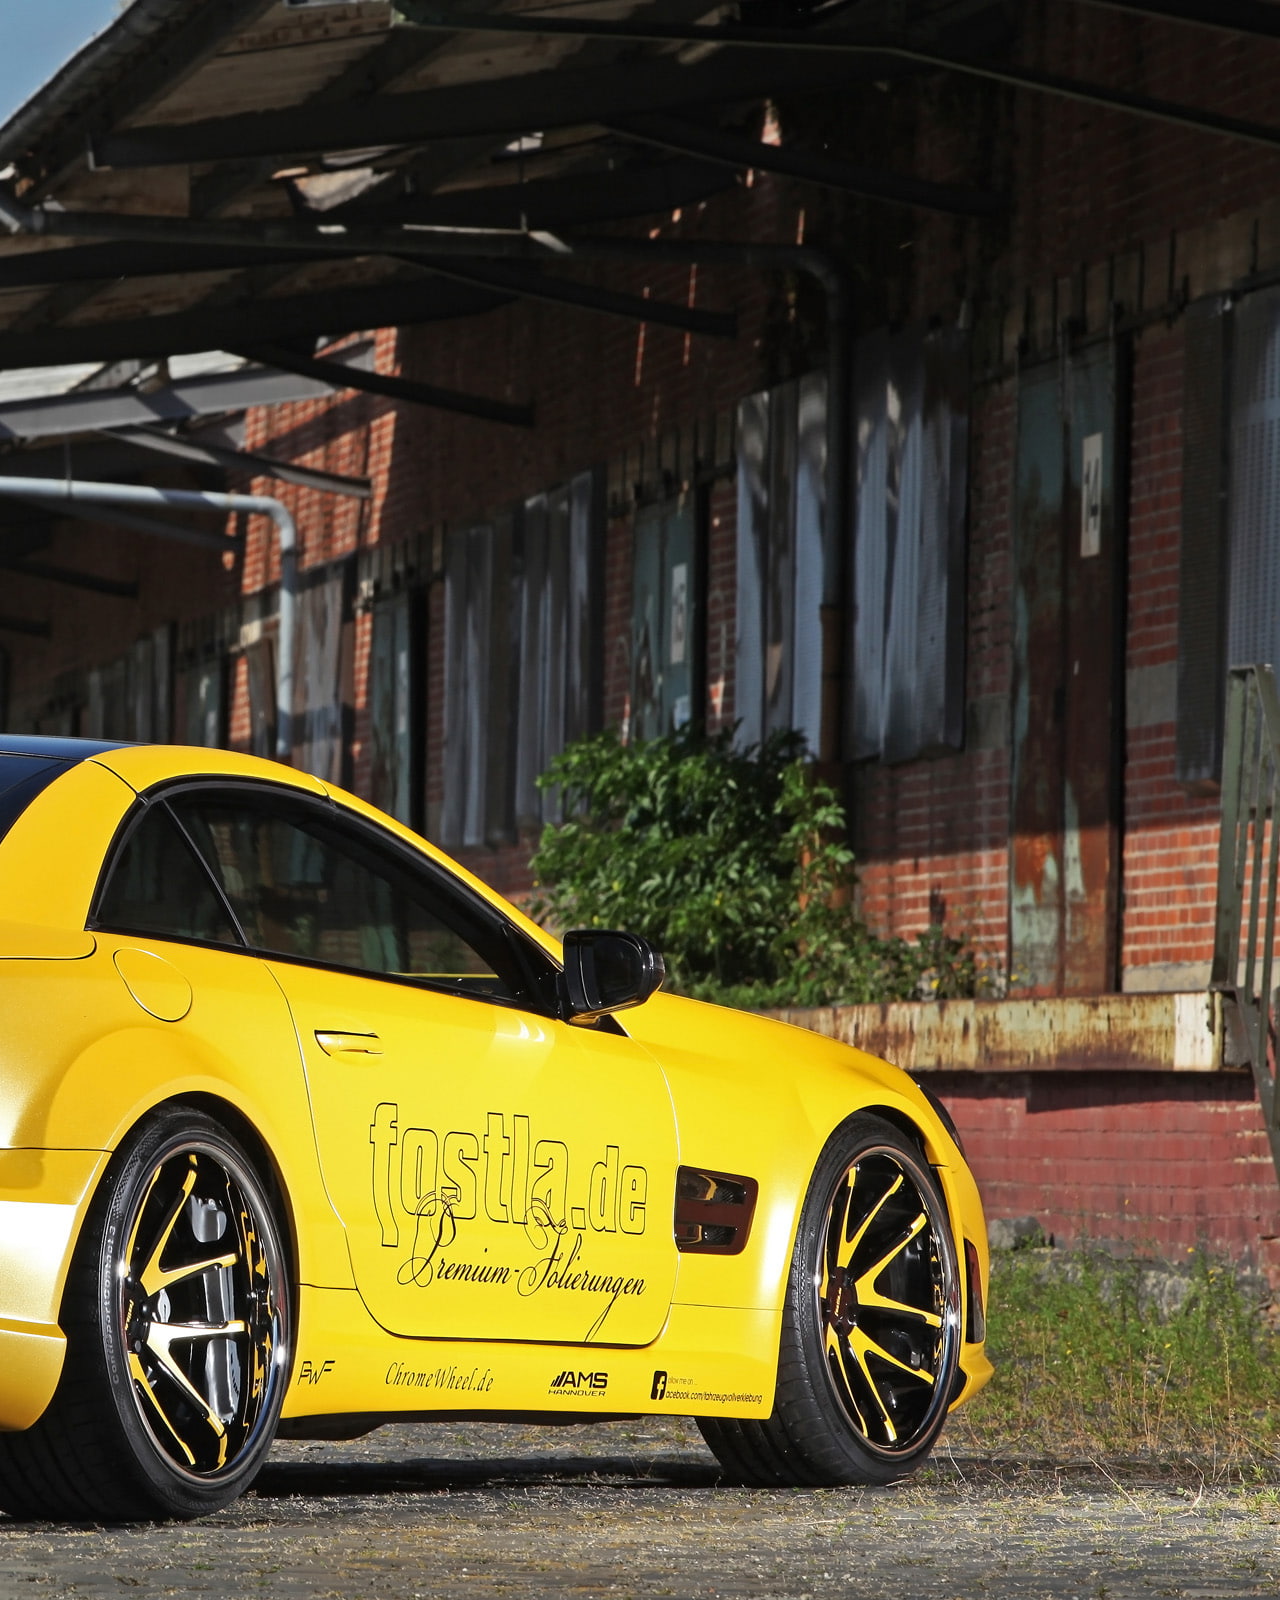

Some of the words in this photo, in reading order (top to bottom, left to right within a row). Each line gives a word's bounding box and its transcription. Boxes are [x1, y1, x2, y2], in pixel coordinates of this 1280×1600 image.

[1084, 457, 1100, 533] 14
[369, 1101, 648, 1247] fostla.de
[385, 1362, 494, 1392] ChromeWheel.de
[548, 1389, 606, 1397] HANNOVER
